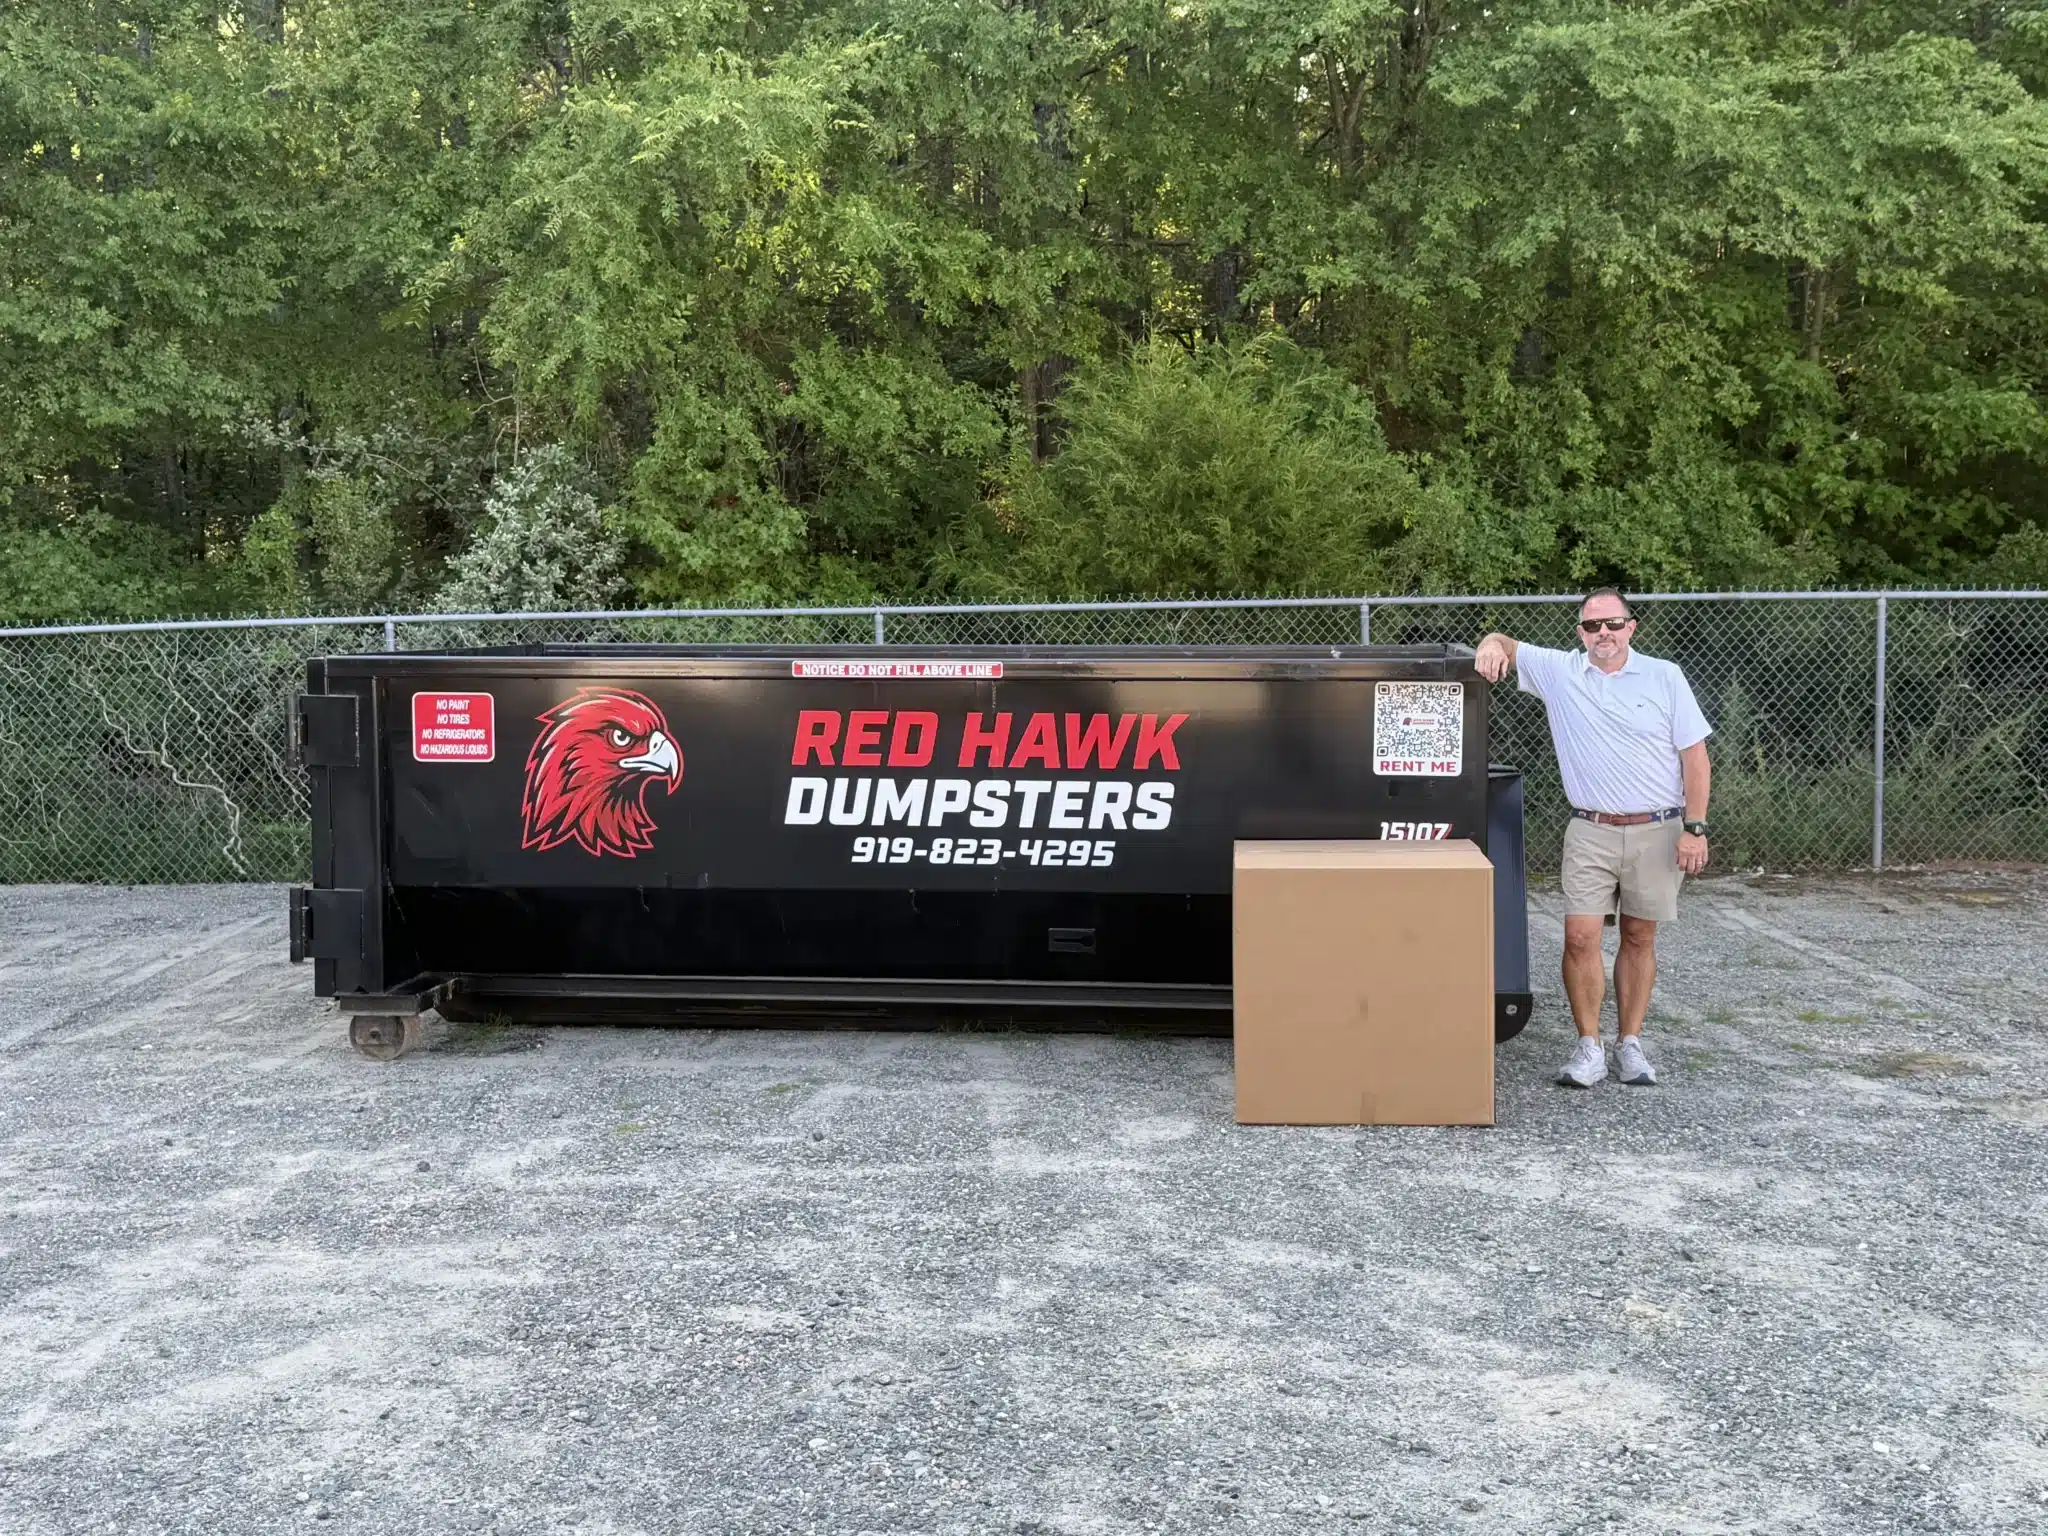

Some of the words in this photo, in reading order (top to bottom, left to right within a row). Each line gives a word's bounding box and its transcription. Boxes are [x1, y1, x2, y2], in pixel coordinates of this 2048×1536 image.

[802, 664, 845, 676] NOTICE
[848, 664, 866, 676] DO
[868, 665, 893, 676] NOT
[896, 665, 920, 676] FILL
[923, 665, 962, 676] ABOVE
[966, 665, 993, 676] LINE
[436, 699, 448, 710] NO
[448, 699, 470, 711] PAINT
[436, 713, 448, 725] NO
[449, 713, 471, 725] TIRES
[421, 728, 433, 740] NO
[433, 728, 486, 740] REFRIGERATORS
[792, 710, 939, 767] RED
[958, 712, 1190, 770] HAWK
[420, 743, 430, 755] NO
[430, 743, 465, 755] HAZARDOUS
[465, 743, 489, 756] LIQUIDS
[1379, 760, 1425, 772] RENT
[1430, 761, 1457, 773] ME
[784, 776, 1175, 831] DUMPSTERS
[1380, 821, 1453, 841] 15107
[851, 836, 1117, 868] 919-823-4295
